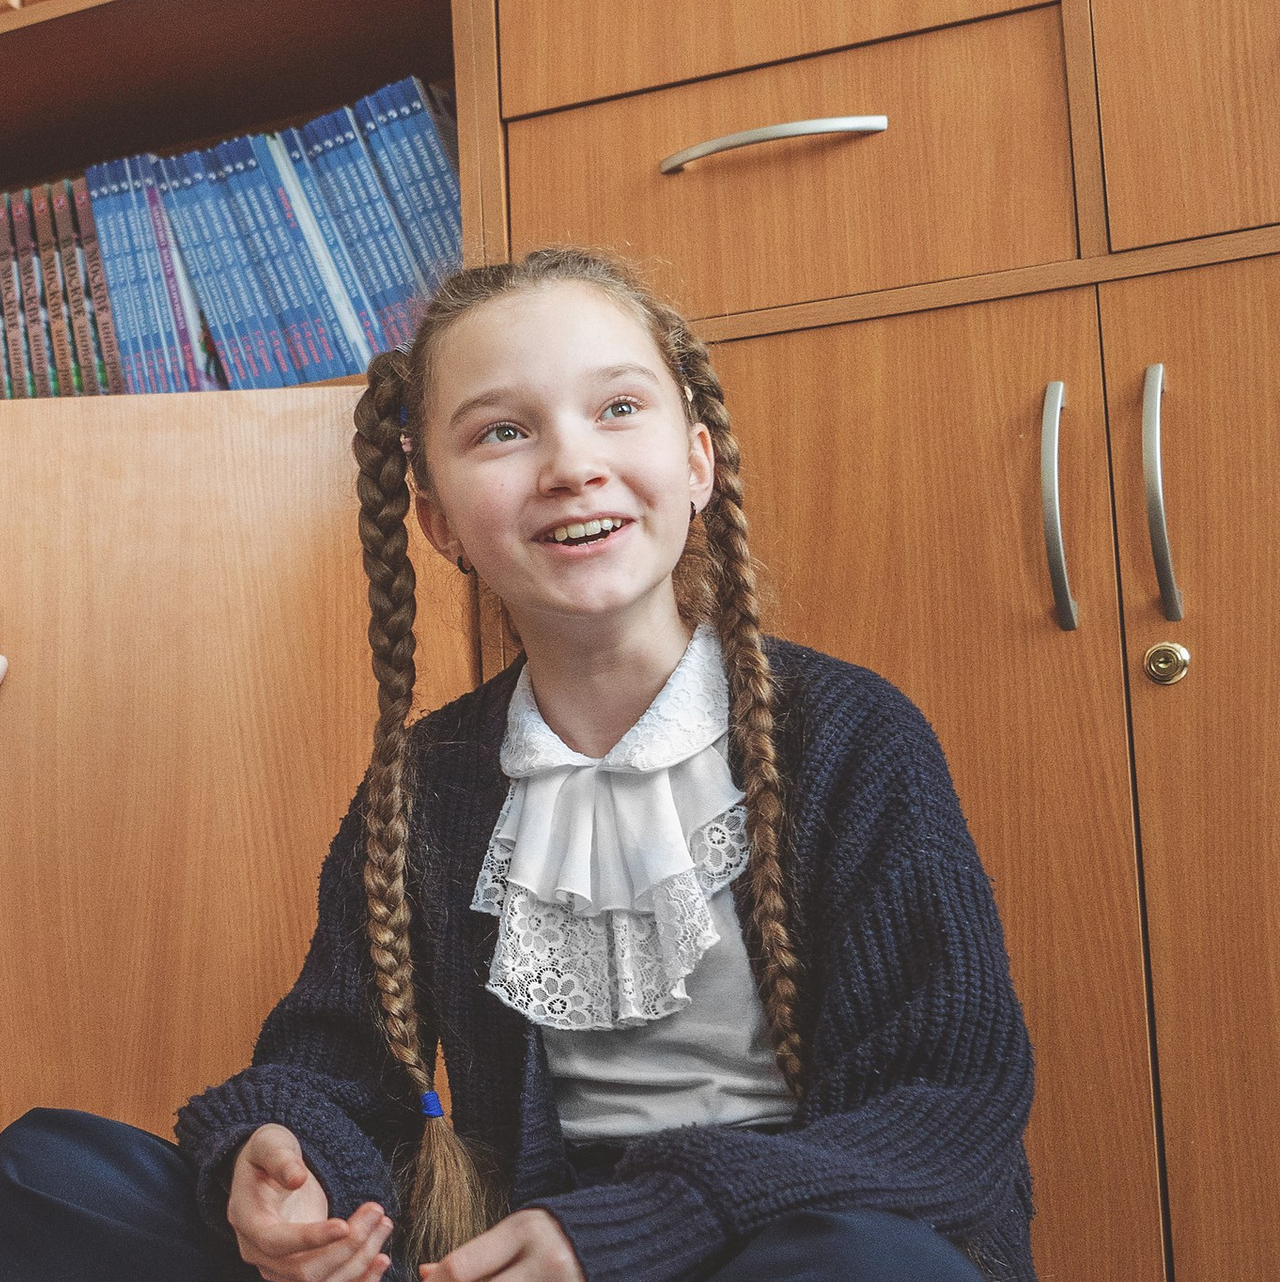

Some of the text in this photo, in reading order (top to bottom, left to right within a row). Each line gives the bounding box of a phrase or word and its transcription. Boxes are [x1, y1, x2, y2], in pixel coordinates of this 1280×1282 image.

[0, 266, 19, 330] МОСКВЕ
[63, 252, 86, 319] МОСКВЕ
[86, 249, 108, 316] МОСКВЕ
[21, 261, 40, 326] МОСКВЕ
[31, 333, 50, 398] интерес
[43, 256, 62, 321] МОСКВЕ
[53, 328, 73, 398] интерес
